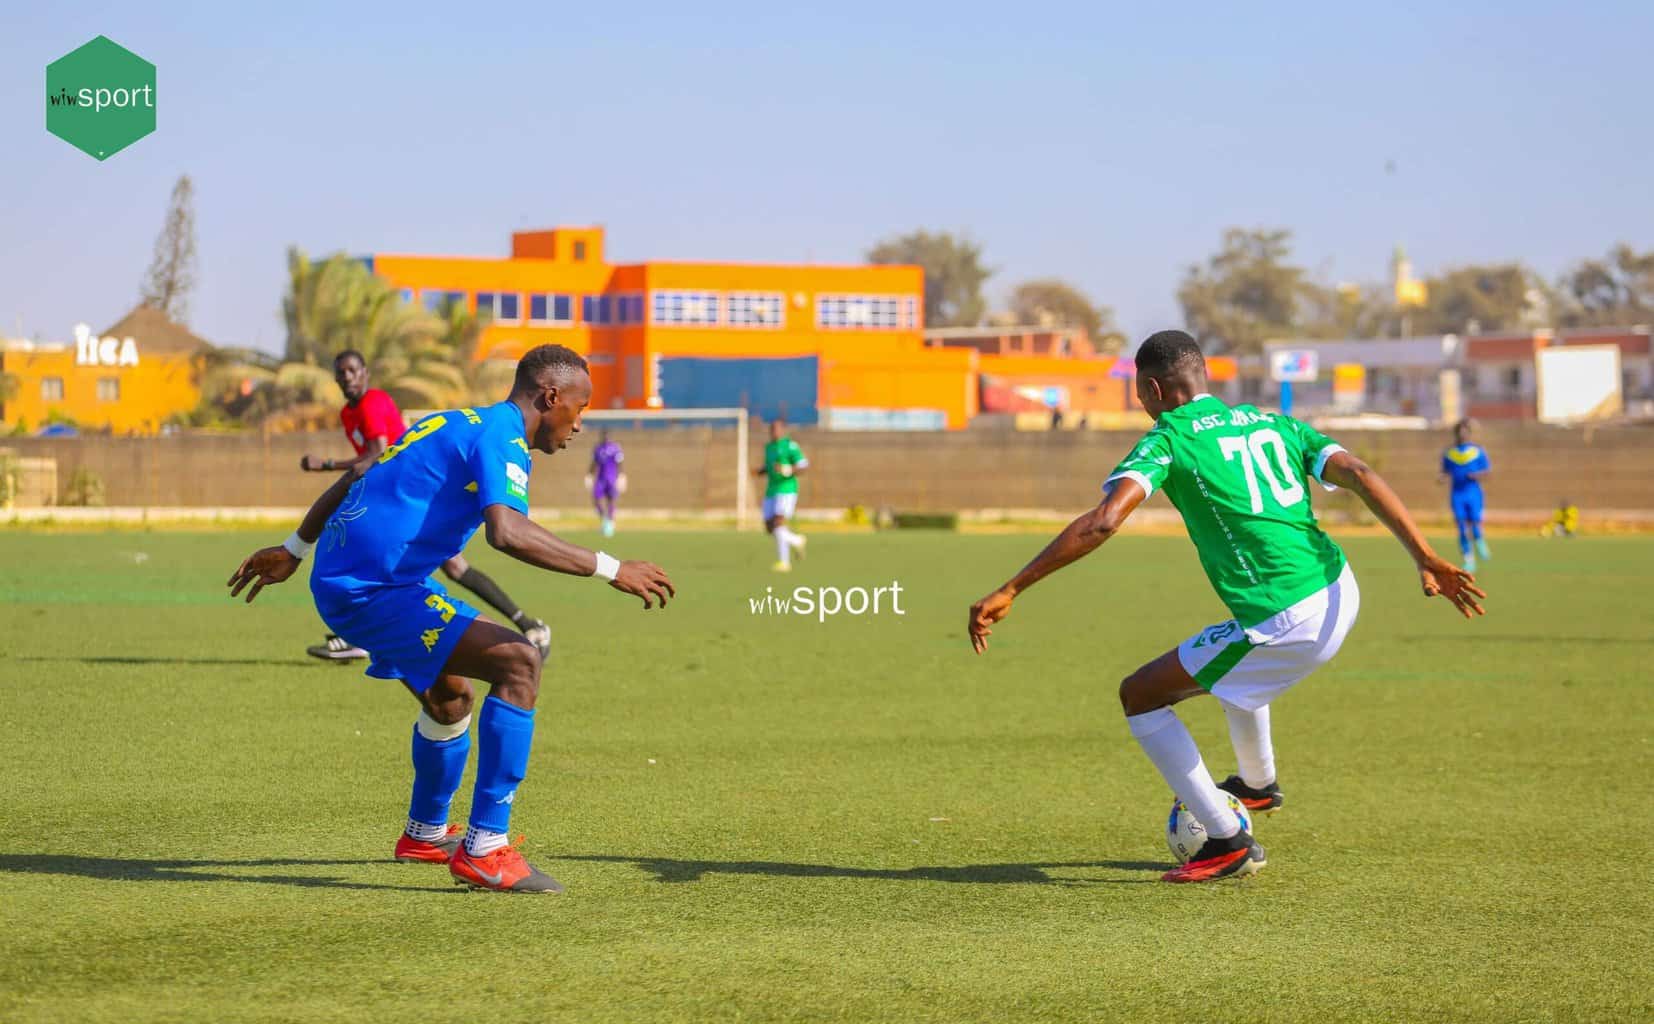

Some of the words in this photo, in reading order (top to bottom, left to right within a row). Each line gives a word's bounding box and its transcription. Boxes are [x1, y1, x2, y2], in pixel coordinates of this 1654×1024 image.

[1192, 414, 1225, 434] ASC
[1217, 428, 1304, 515] 70
[425, 594, 457, 624] 3
